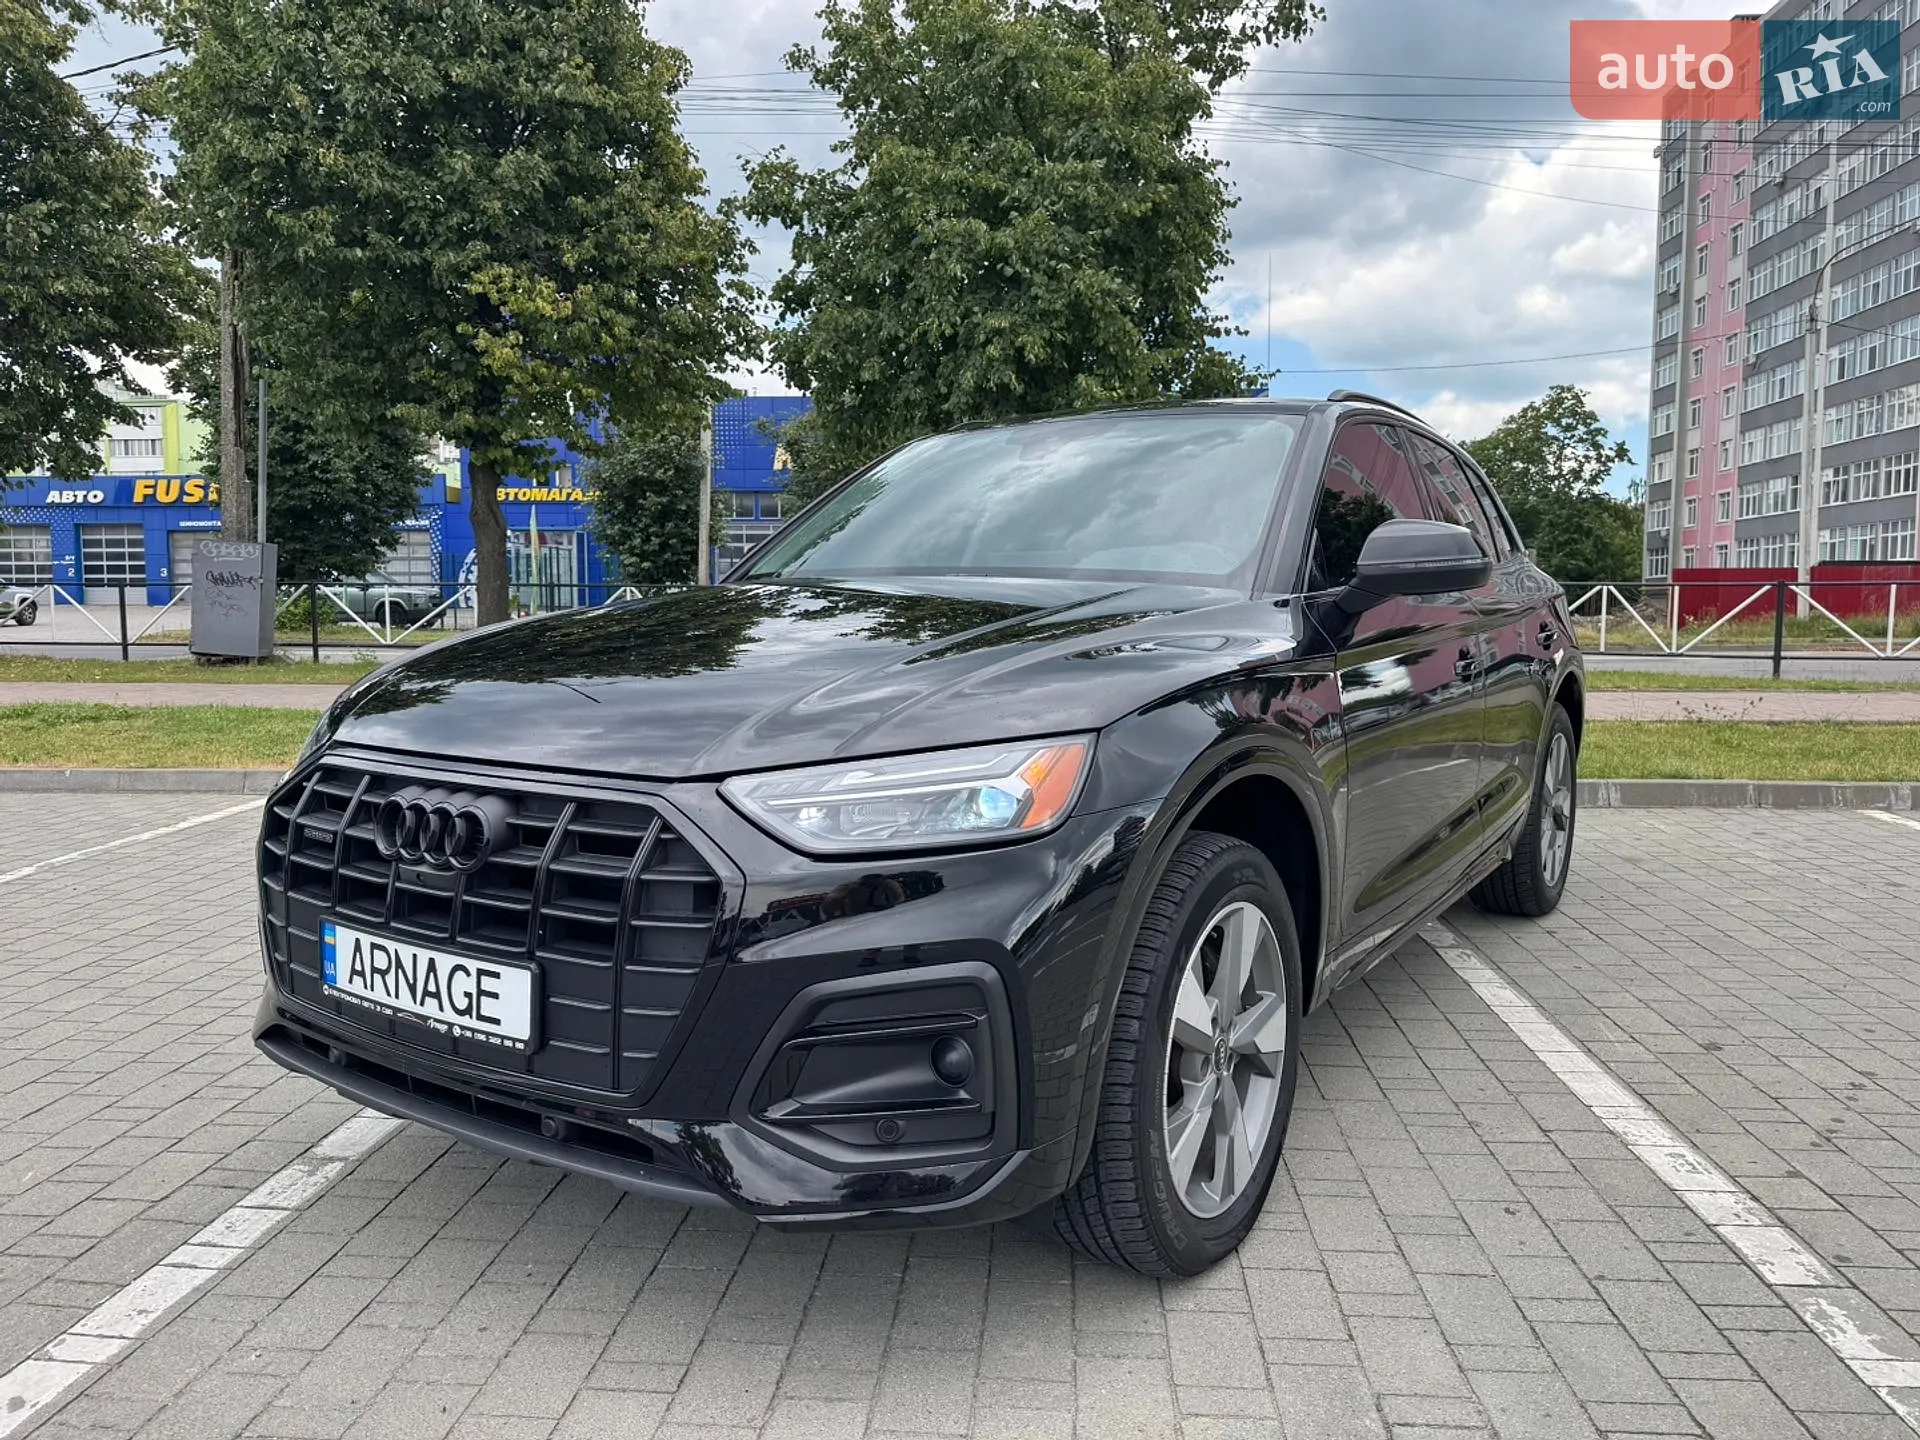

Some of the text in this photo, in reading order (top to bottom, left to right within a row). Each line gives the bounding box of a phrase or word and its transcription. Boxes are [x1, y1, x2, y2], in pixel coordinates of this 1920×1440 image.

[45, 490, 105, 504] АВТО
[67, 567, 76, 578] 2
[160, 567, 168, 578] 3
[323, 959, 336, 977] UA
[347, 937, 502, 1027] ARNAGE
